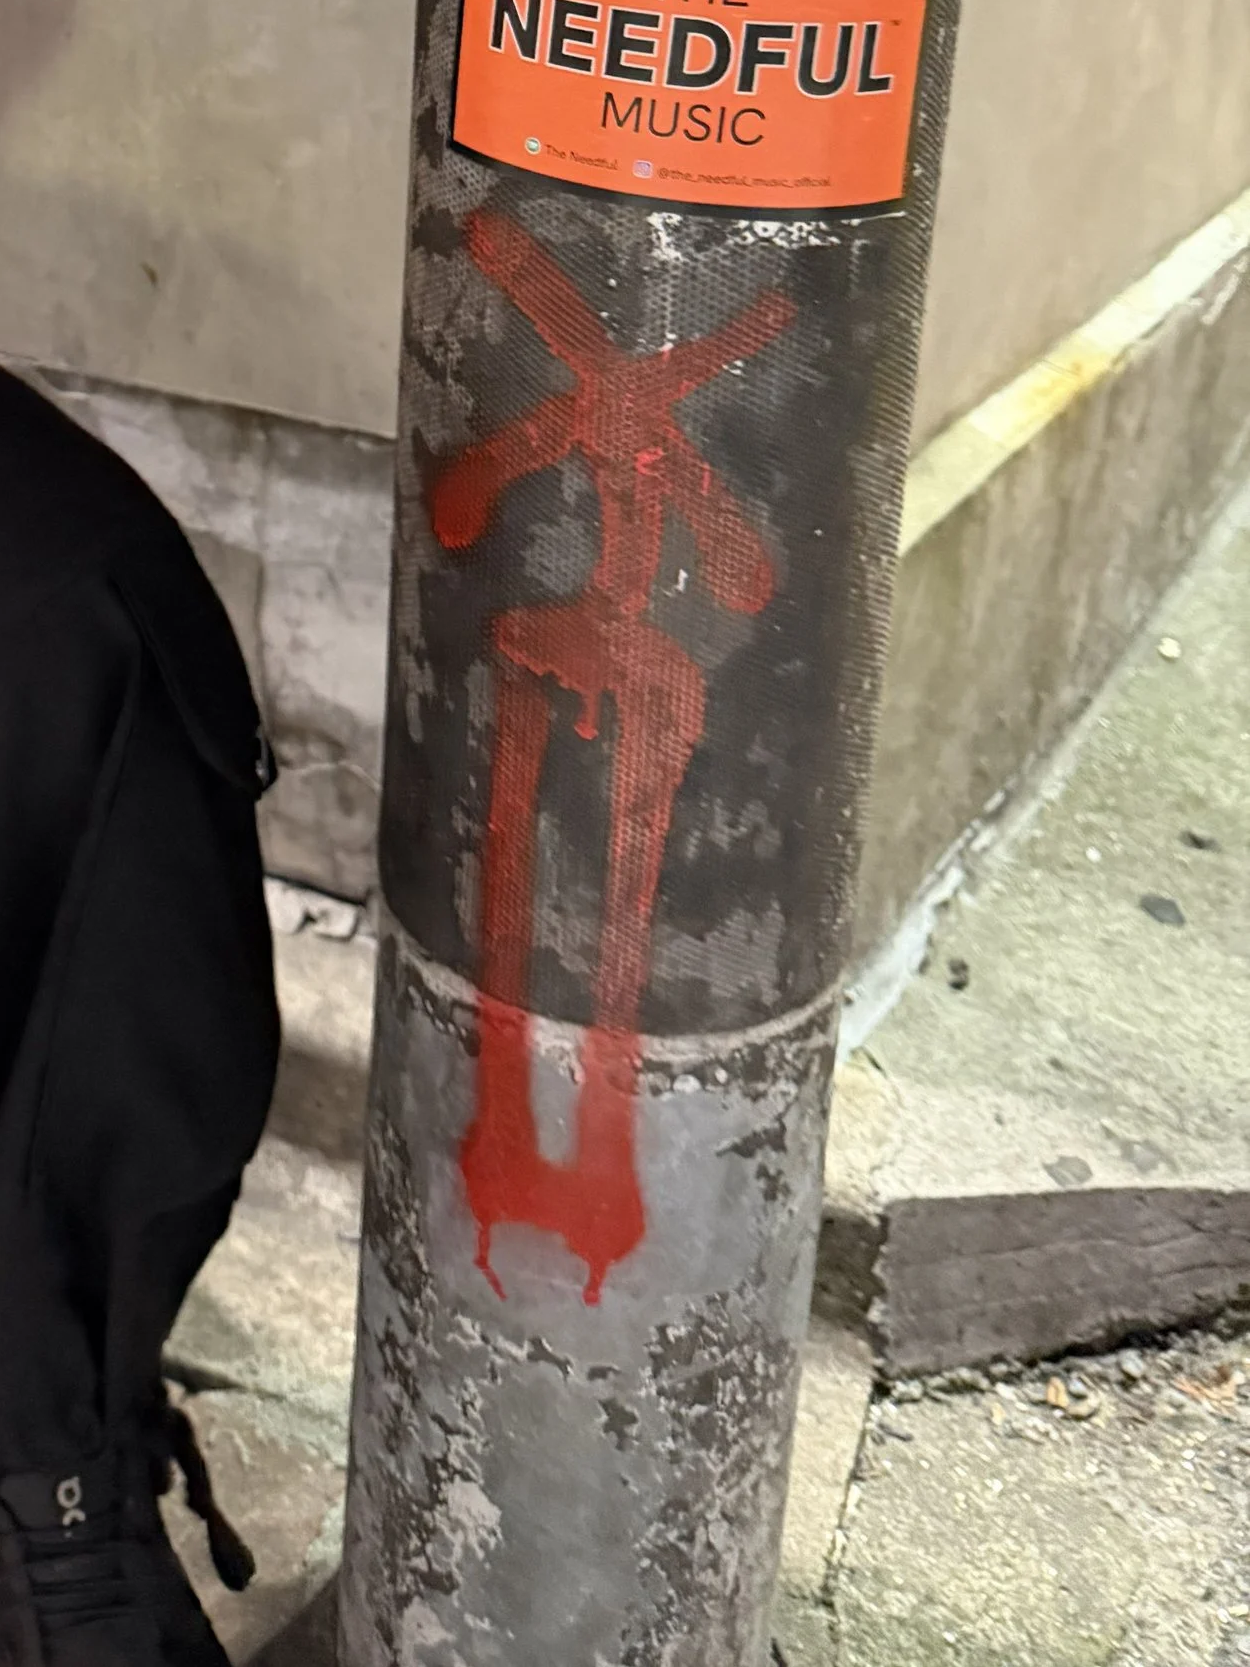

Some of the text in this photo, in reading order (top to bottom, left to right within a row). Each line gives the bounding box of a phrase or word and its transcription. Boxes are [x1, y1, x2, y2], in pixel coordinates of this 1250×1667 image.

[600, 91, 766, 146] MUSIC
[545, 143, 619, 171] The Needful
